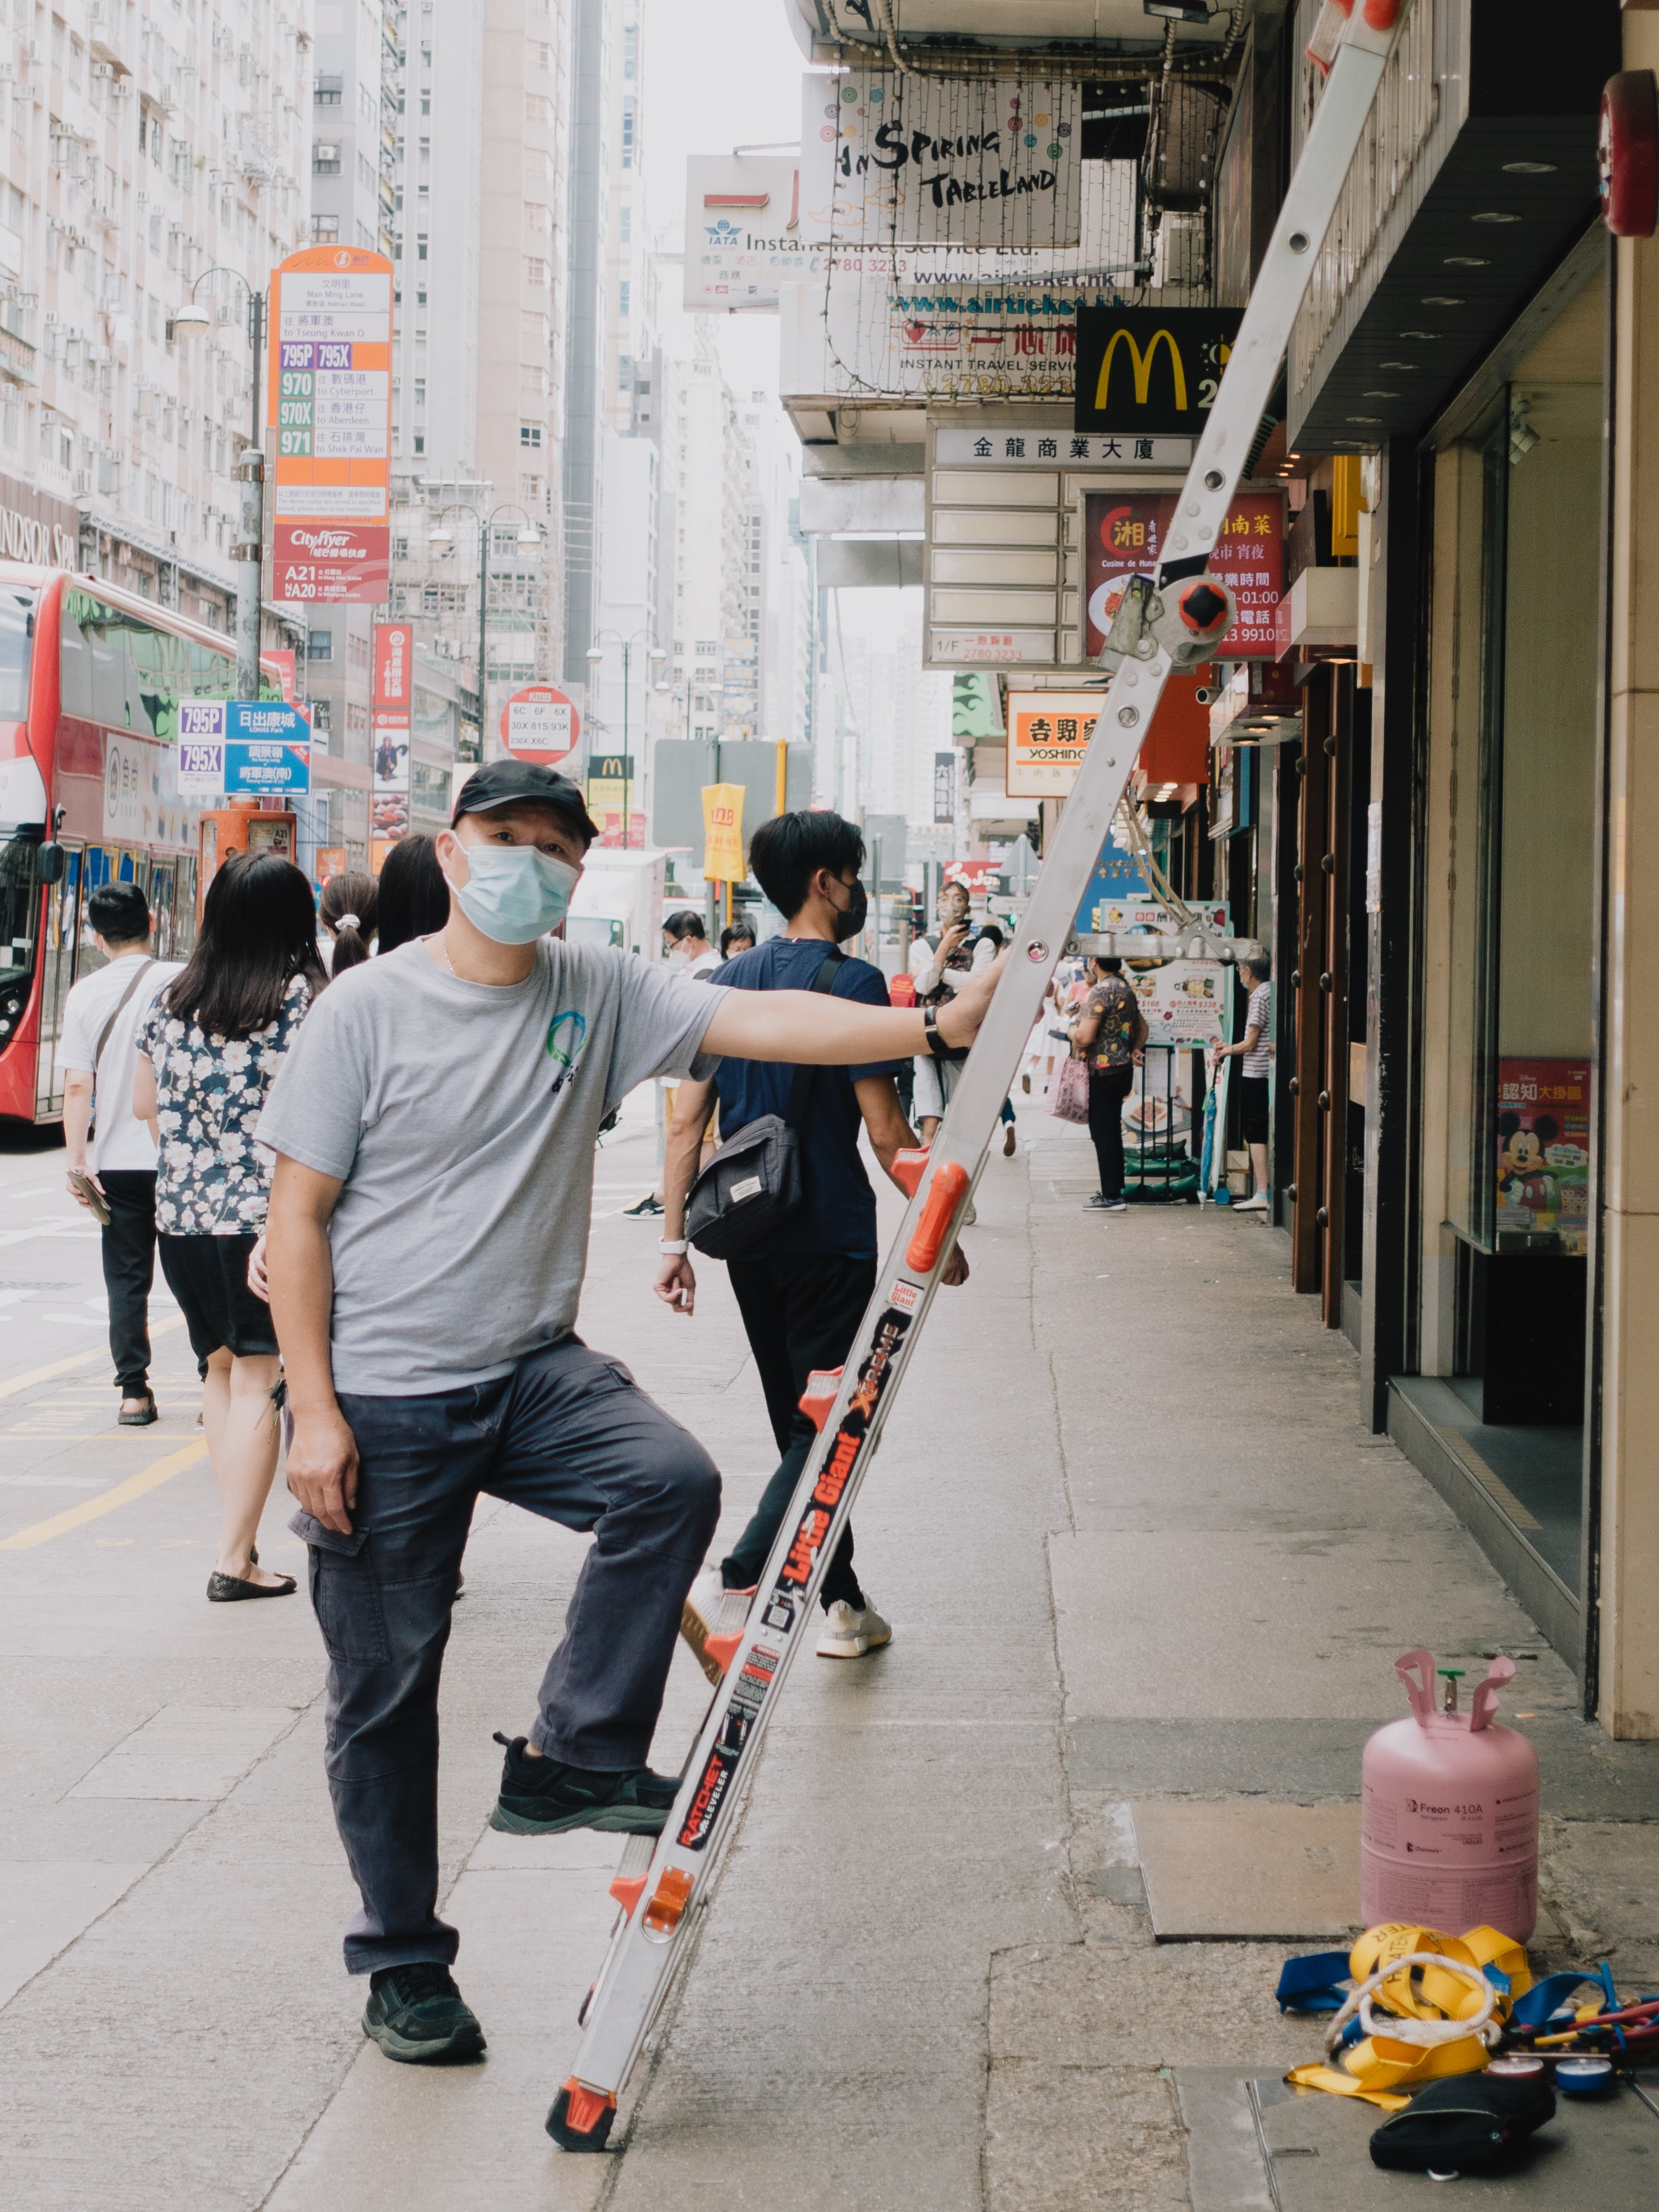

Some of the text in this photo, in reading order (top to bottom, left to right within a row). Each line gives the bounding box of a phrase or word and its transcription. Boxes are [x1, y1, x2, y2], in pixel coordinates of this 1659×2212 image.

[321, 279, 350, 289] 文明里
[325, 291, 343, 299] Ming
[296, 329, 327, 339] Tseung
[283, 344, 349, 368] 795P 795X
[901, 360, 963, 370] INSTANT
[969, 360, 1024, 370] TRAVEL
[282, 373, 311, 395] 970
[330, 387, 373, 398] Cyberport
[281, 402, 311, 425] 970X
[329, 416, 369, 424] Aberdeen
[281, 431, 311, 453] 971
[328, 445, 347, 453] Shek
[350, 445, 361, 453] Pai
[365, 445, 383, 453] Wan
[973, 436, 1155, 460] 金龍商業大廈
[1114, 521, 1145, 547] 湘
[285, 566, 315, 580] A21
[1241, 629, 1275, 642] 9910
[937, 640, 959, 651] 1/F
[964, 648, 1023, 660] 2780 3233
[514, 707, 526, 715] 6C
[535, 707, 546, 715] 6F
[184, 708, 220, 733] 795P
[240, 711, 295, 728] 日出康城
[511, 722, 528, 730] 30X
[531, 722, 548, 730] 81S
[184, 746, 219, 772] 795X
[275, 829, 287, 838] A21
[1498, 1083, 1582, 1100] 認知大掛圖
[894, 1283, 918, 1298] Little
[891, 1292, 915, 1307] Giant
[814, 1432, 861, 1506] Giant
[704, 1769, 728, 1820] LEVELER
[1420, 1803, 1483, 1814] Freon 410A
